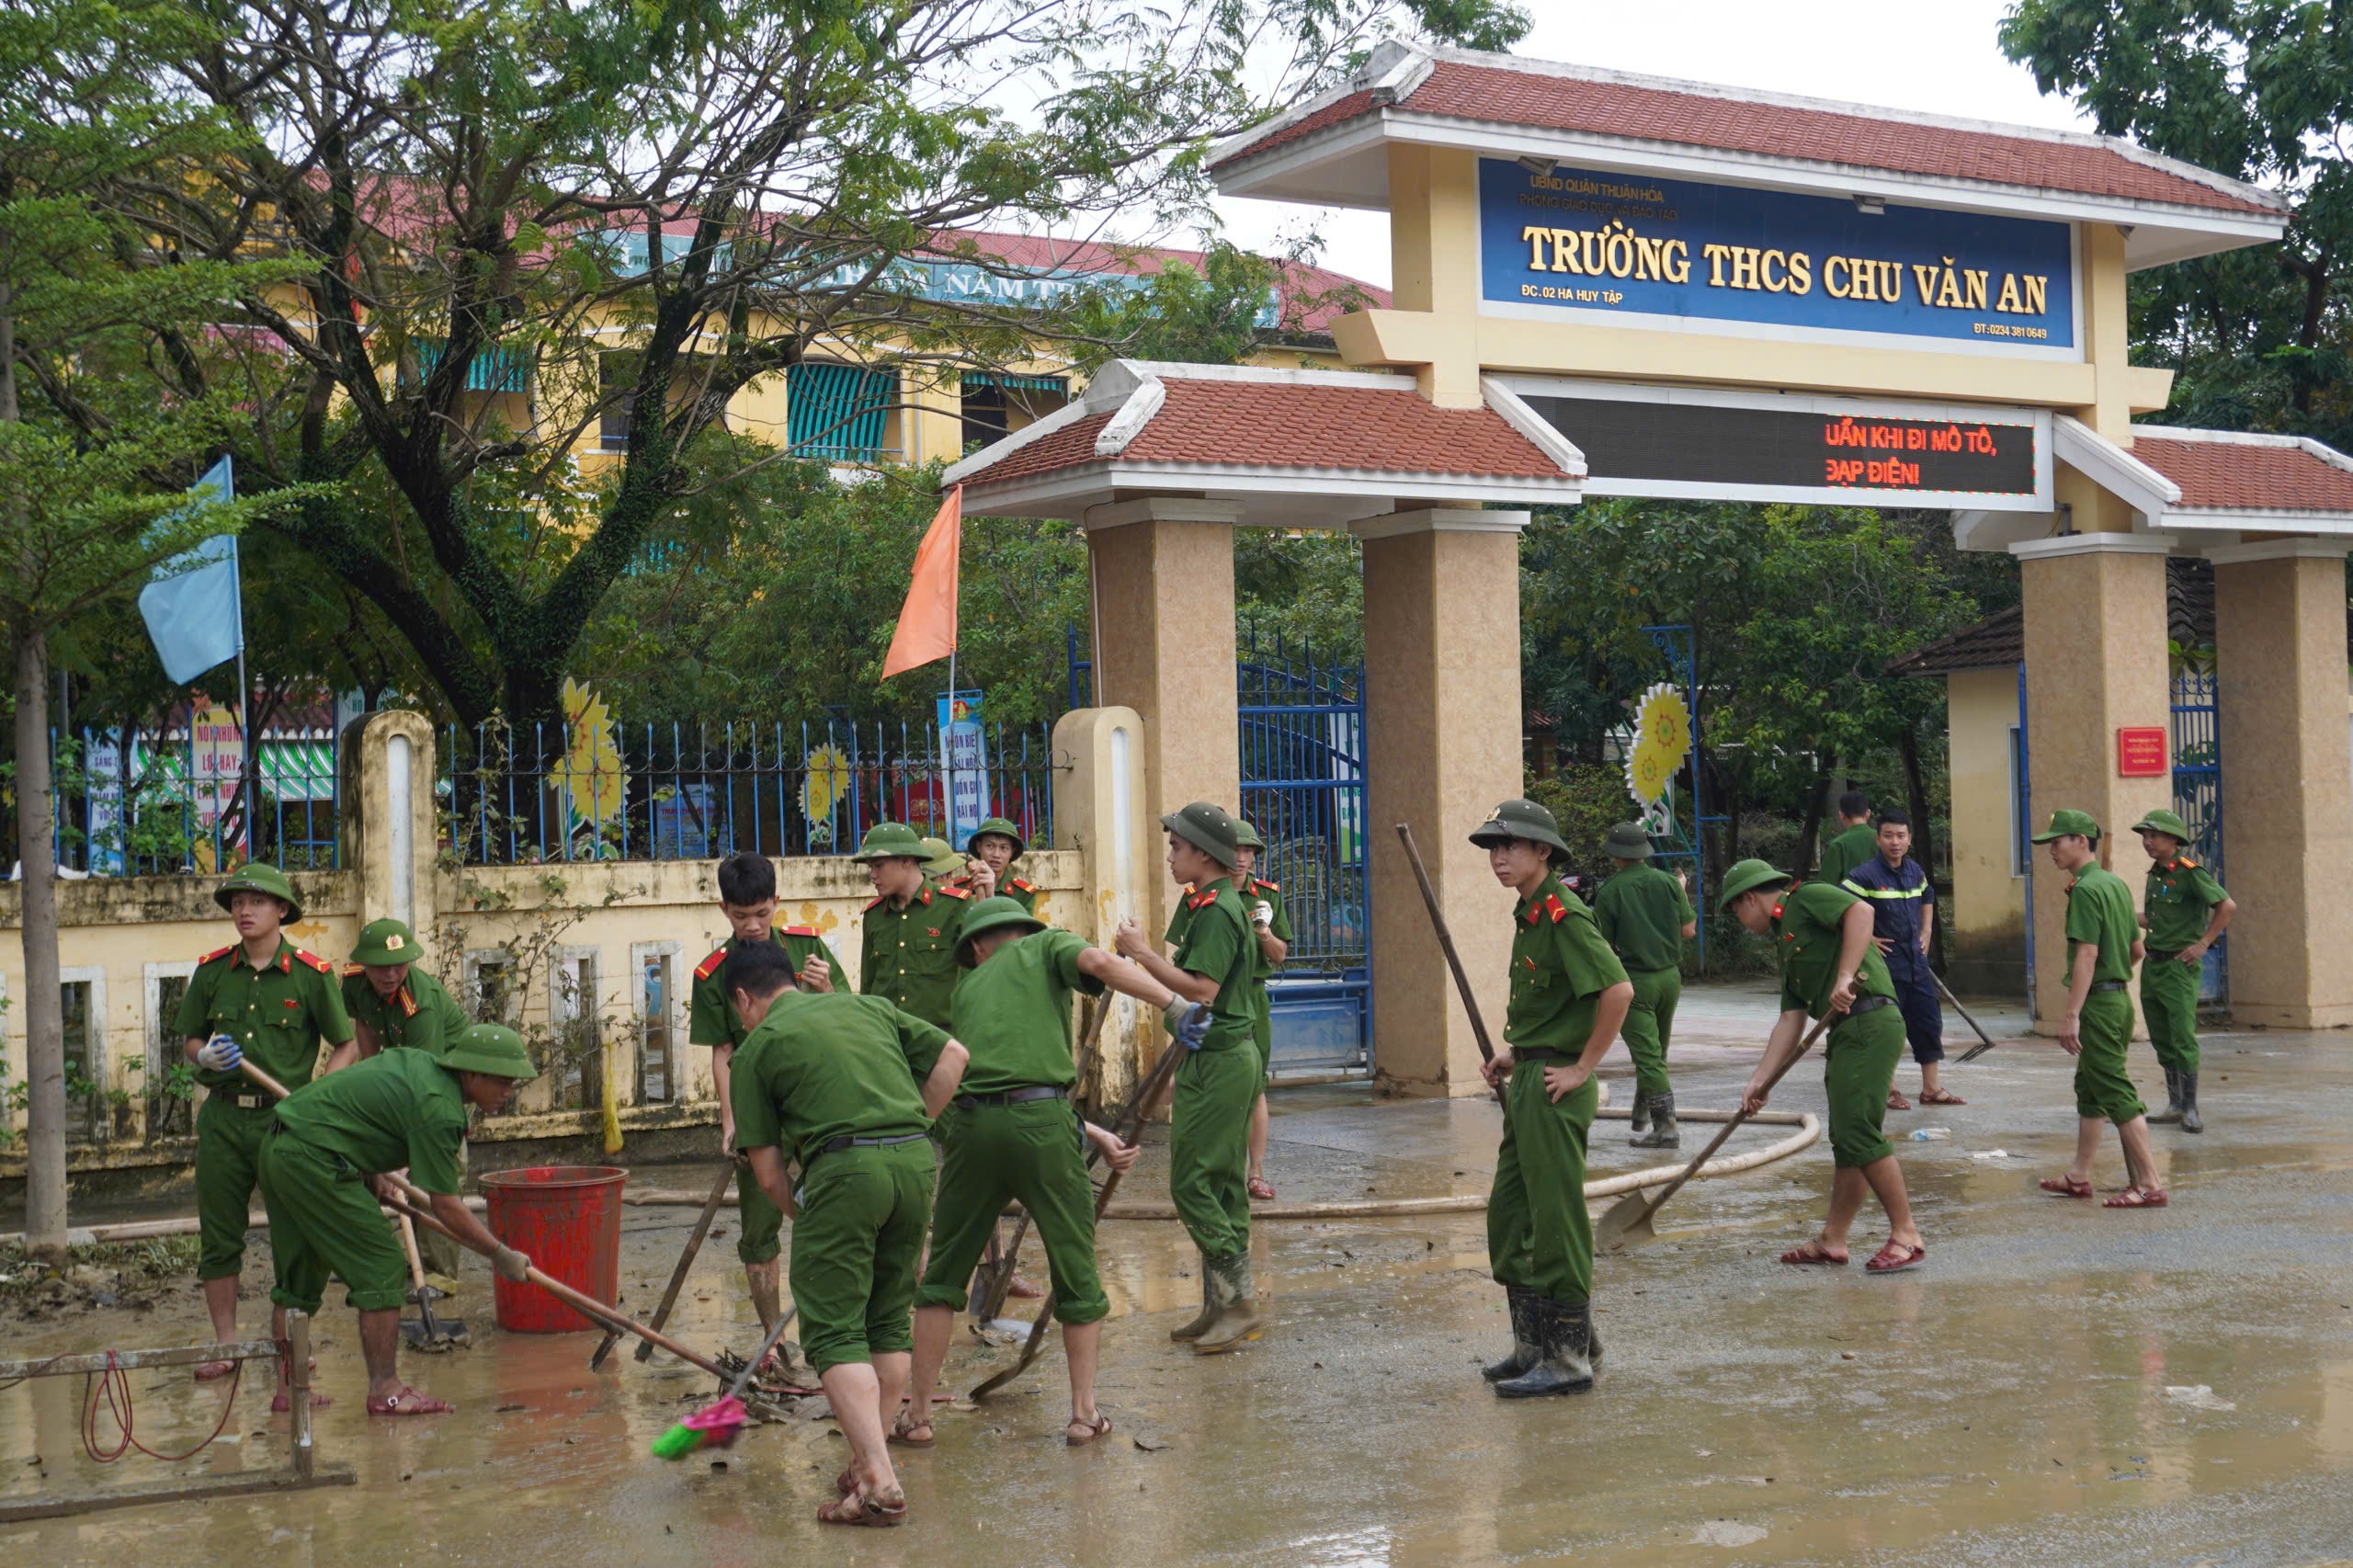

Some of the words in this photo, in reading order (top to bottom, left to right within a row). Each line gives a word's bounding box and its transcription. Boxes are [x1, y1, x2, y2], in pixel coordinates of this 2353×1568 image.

[1529, 175, 1563, 191] UBND
[1565, 177, 1598, 196] QUẬN
[1522, 217, 1691, 284] TRƯỜNG
[1703, 243, 1812, 296] THCS
[1824, 255, 1904, 303] CHU
[1911, 255, 1989, 310] VĂN
[1995, 272, 2048, 316] AN
[1575, 290, 1599, 303] HUY
[1602, 289, 1623, 305] TẬP
[2010, 325, 2026, 338] 381
[2026, 327, 2048, 340] 0649
[1870, 426, 1904, 449] KHI
[1905, 427, 1927, 450] ĐI
[1931, 424, 1962, 453] MÔ
[1964, 426, 1997, 457] TÔ,
[1867, 456, 1920, 489] ĐIỆN!
